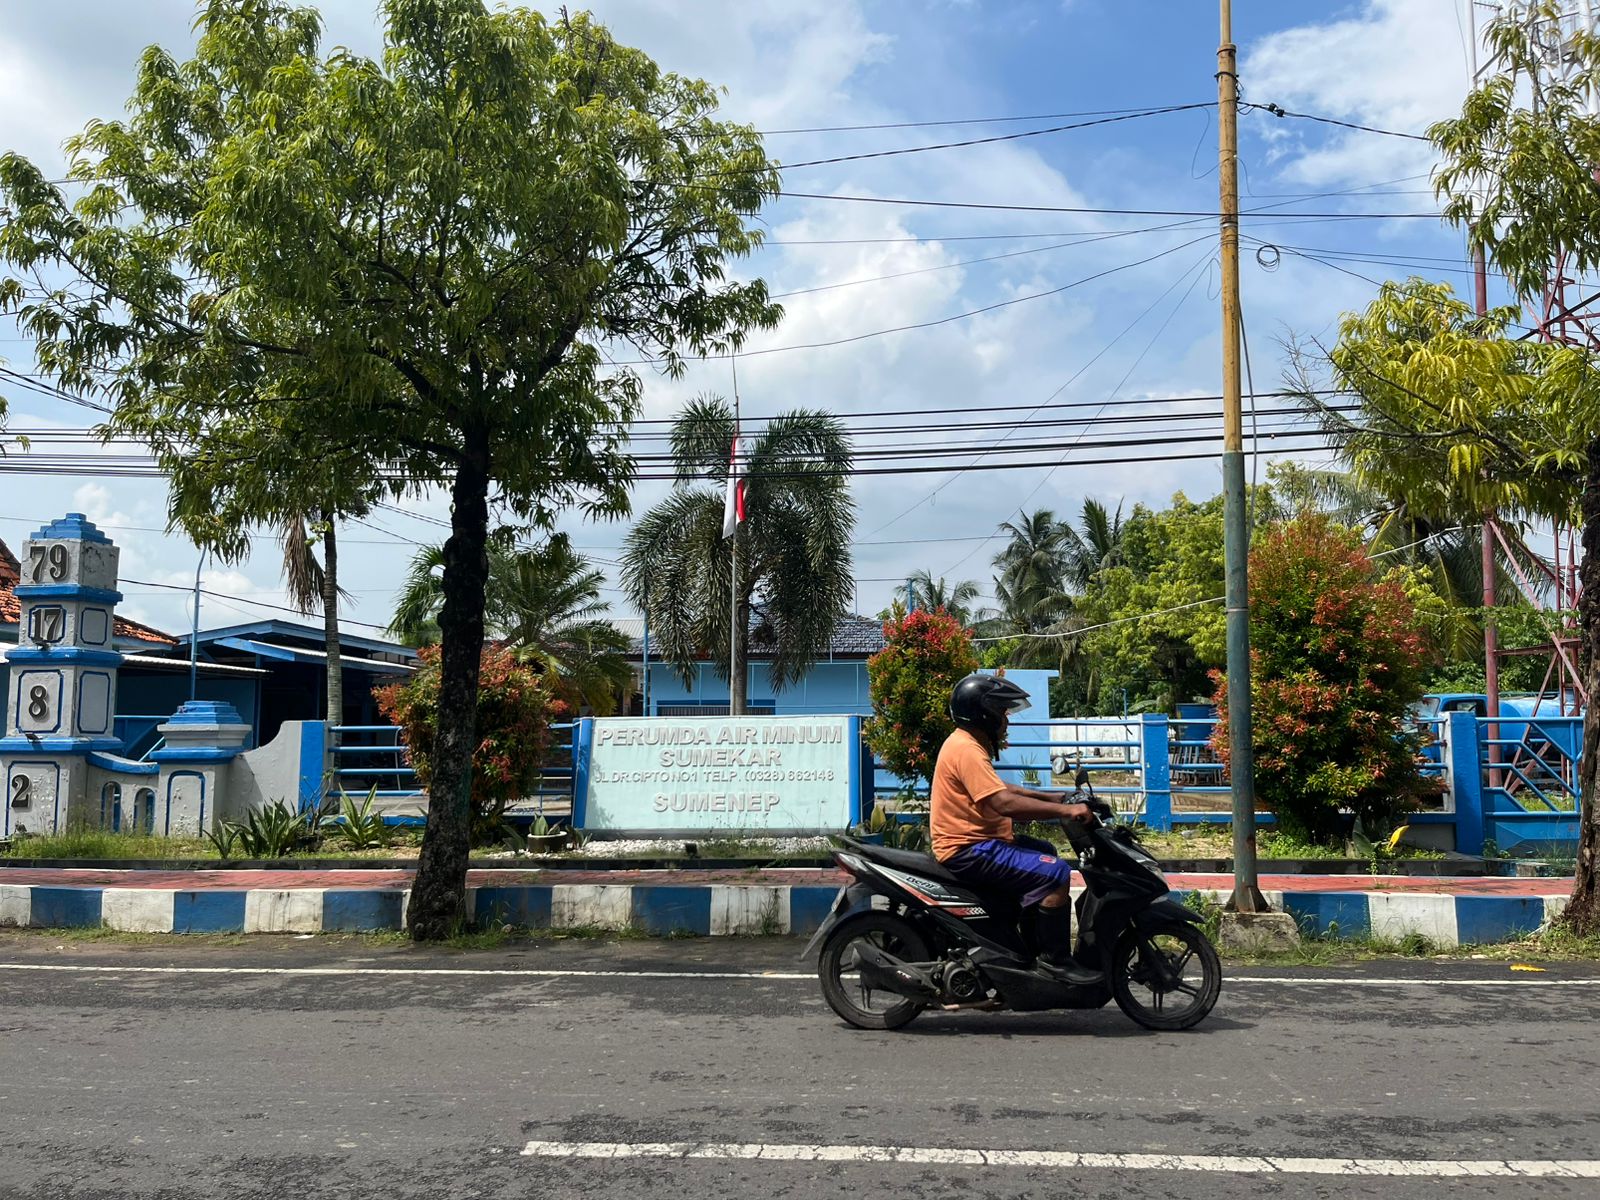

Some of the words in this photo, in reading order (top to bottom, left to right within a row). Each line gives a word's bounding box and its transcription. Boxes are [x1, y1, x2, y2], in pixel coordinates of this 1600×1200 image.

[30, 544, 69, 583] 79
[31, 608, 62, 642] 17
[28, 685, 49, 719] 8
[596, 726, 713, 747] PERUMDA
[716, 726, 758, 746] AIR
[762, 725, 842, 745] MINUM
[659, 748, 782, 768] SUMEKAR
[744, 770, 785, 782] (0328)
[787, 769, 835, 782] 662148
[11, 774, 31, 808] 2
[653, 792, 781, 812] SUMENEP
